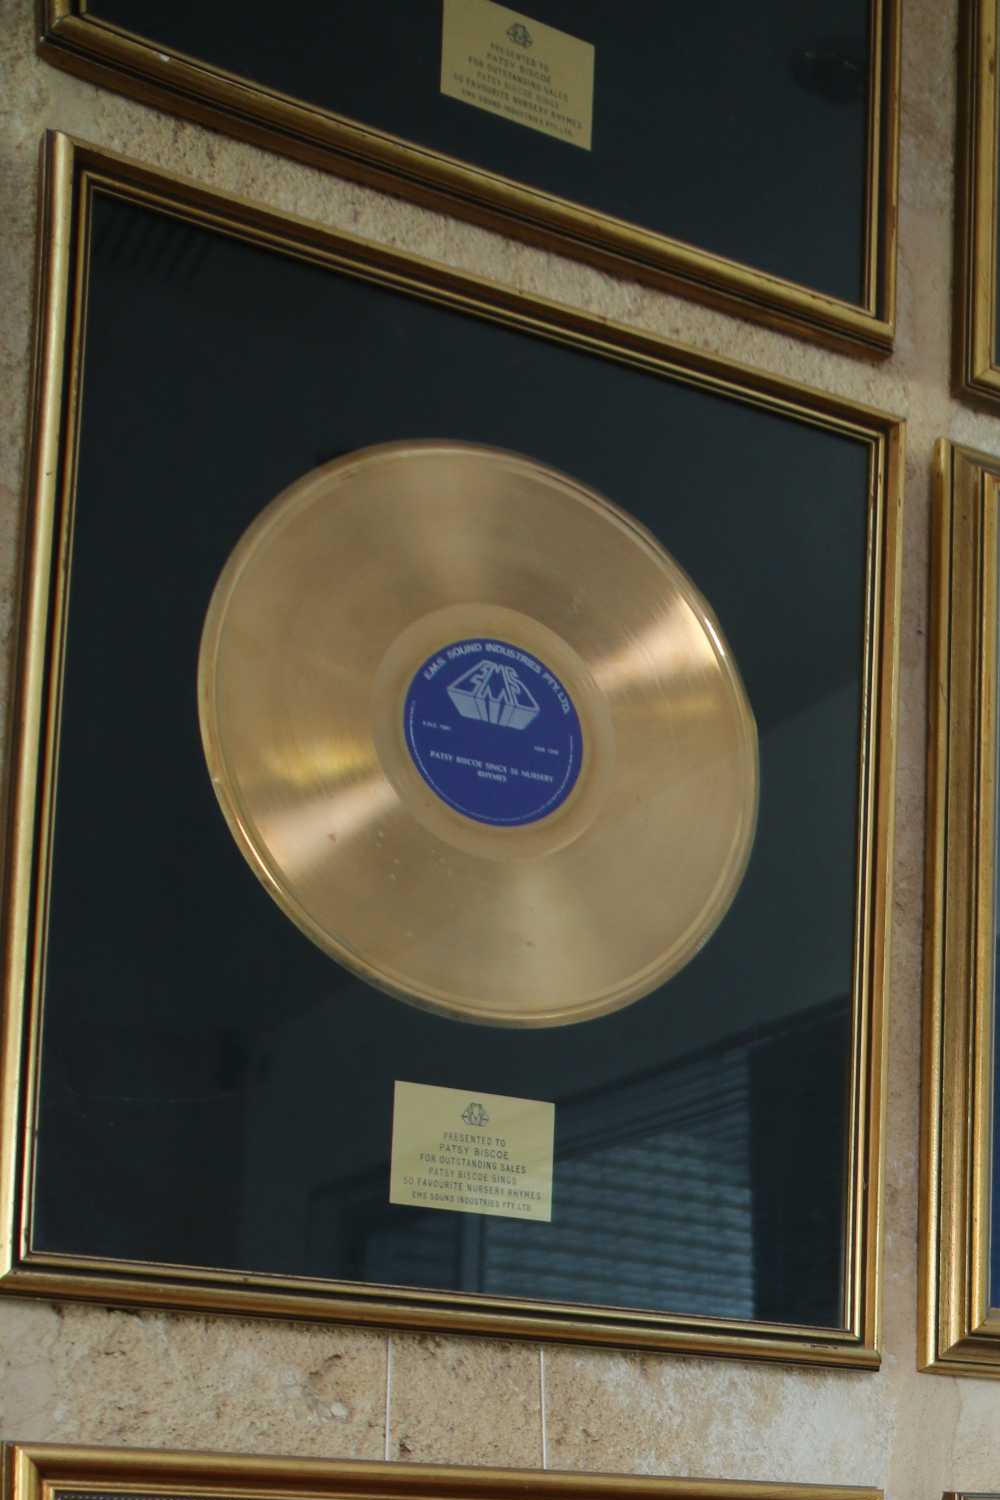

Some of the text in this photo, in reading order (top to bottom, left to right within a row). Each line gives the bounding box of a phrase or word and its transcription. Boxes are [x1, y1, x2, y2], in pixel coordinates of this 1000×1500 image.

[447, 643, 482, 659] SOUND
[485, 643, 541, 674] INDUSTRIES
[445, 1131, 506, 1148] PRESENTED TO
[440, 1143, 509, 1160] PATSY BISCOE
[420, 1153, 527, 1174] FOR OUTSTANDING SALES
[429, 1167, 517, 1186] PATSY BISCOE SINGS
[417, 1178, 463, 1191] FAVOURITE
[468, 1184, 504, 1196] NURSERY
[508, 1189, 542, 1201] RHYMES
